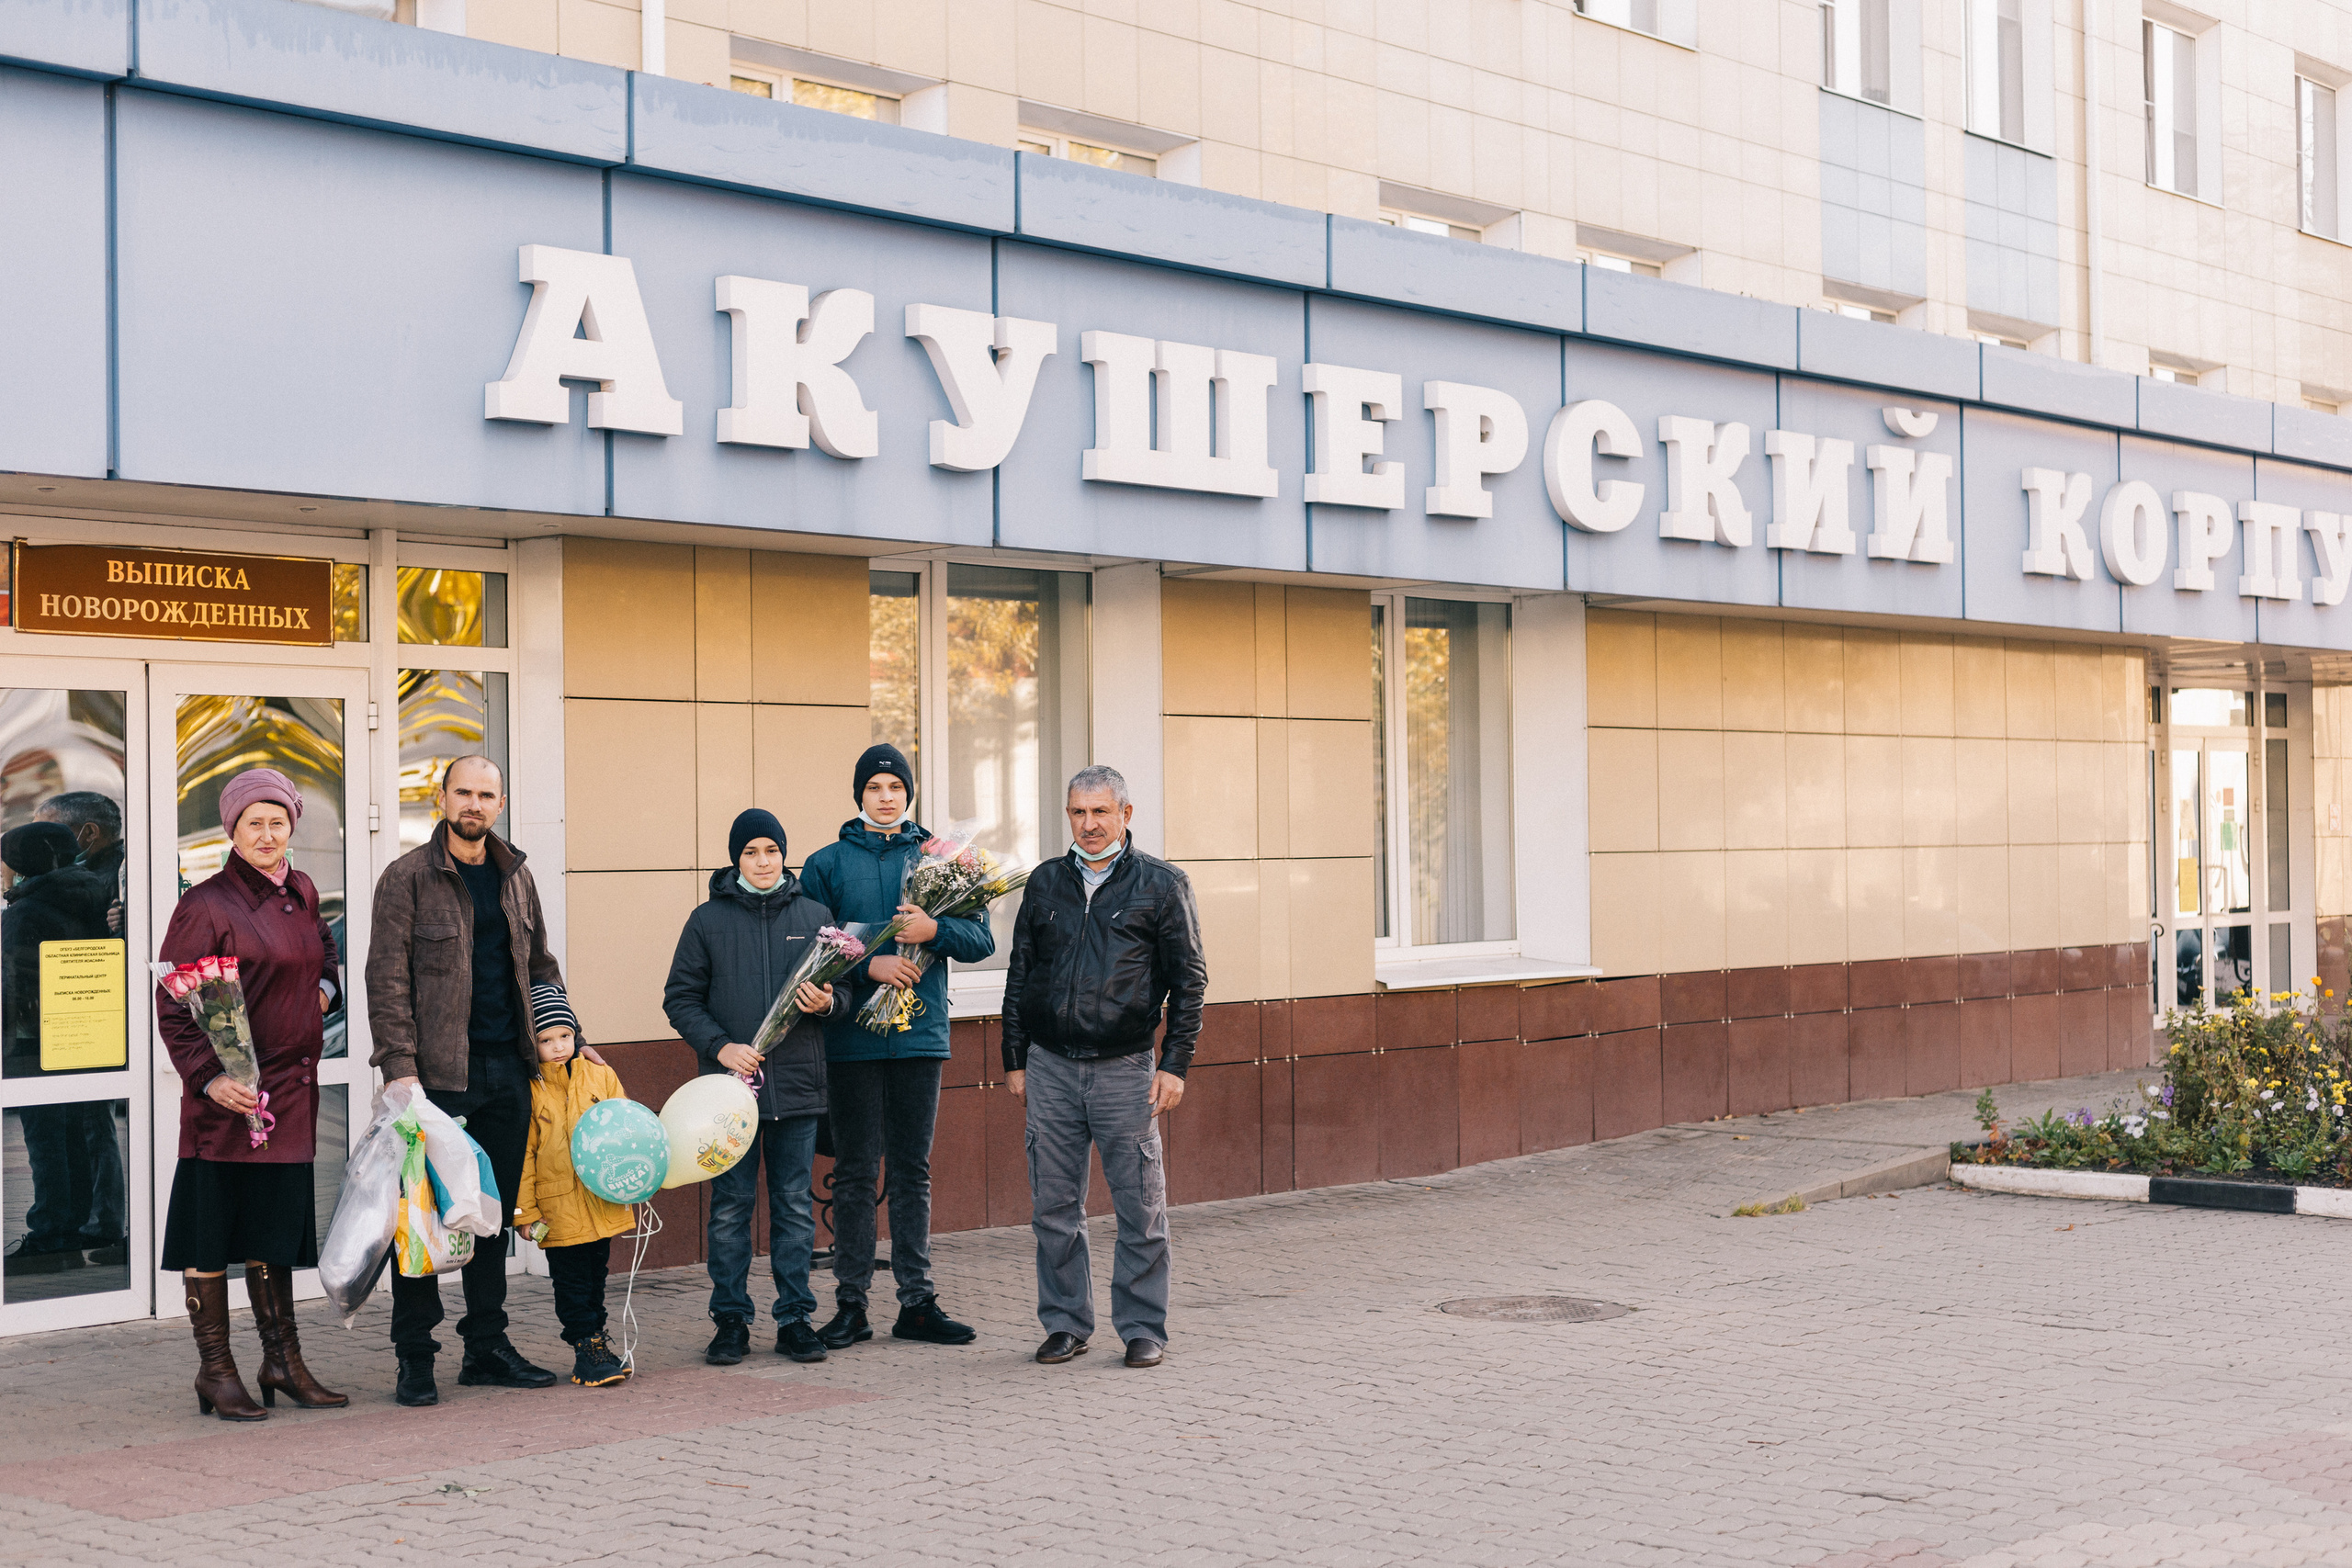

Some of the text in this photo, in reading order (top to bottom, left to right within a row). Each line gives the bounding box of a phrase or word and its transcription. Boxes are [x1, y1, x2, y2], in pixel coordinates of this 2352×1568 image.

[485, 243, 2352, 606] АКУШЕРСКИЙ КОРПУ
[107, 559, 251, 591] ВЫПИСКА
[40, 593, 311, 629] НОВОРОЖДЕННЫХ
[606, 1168, 635, 1183] Спасибо
[607, 1164, 650, 1190] ВНУКА!
